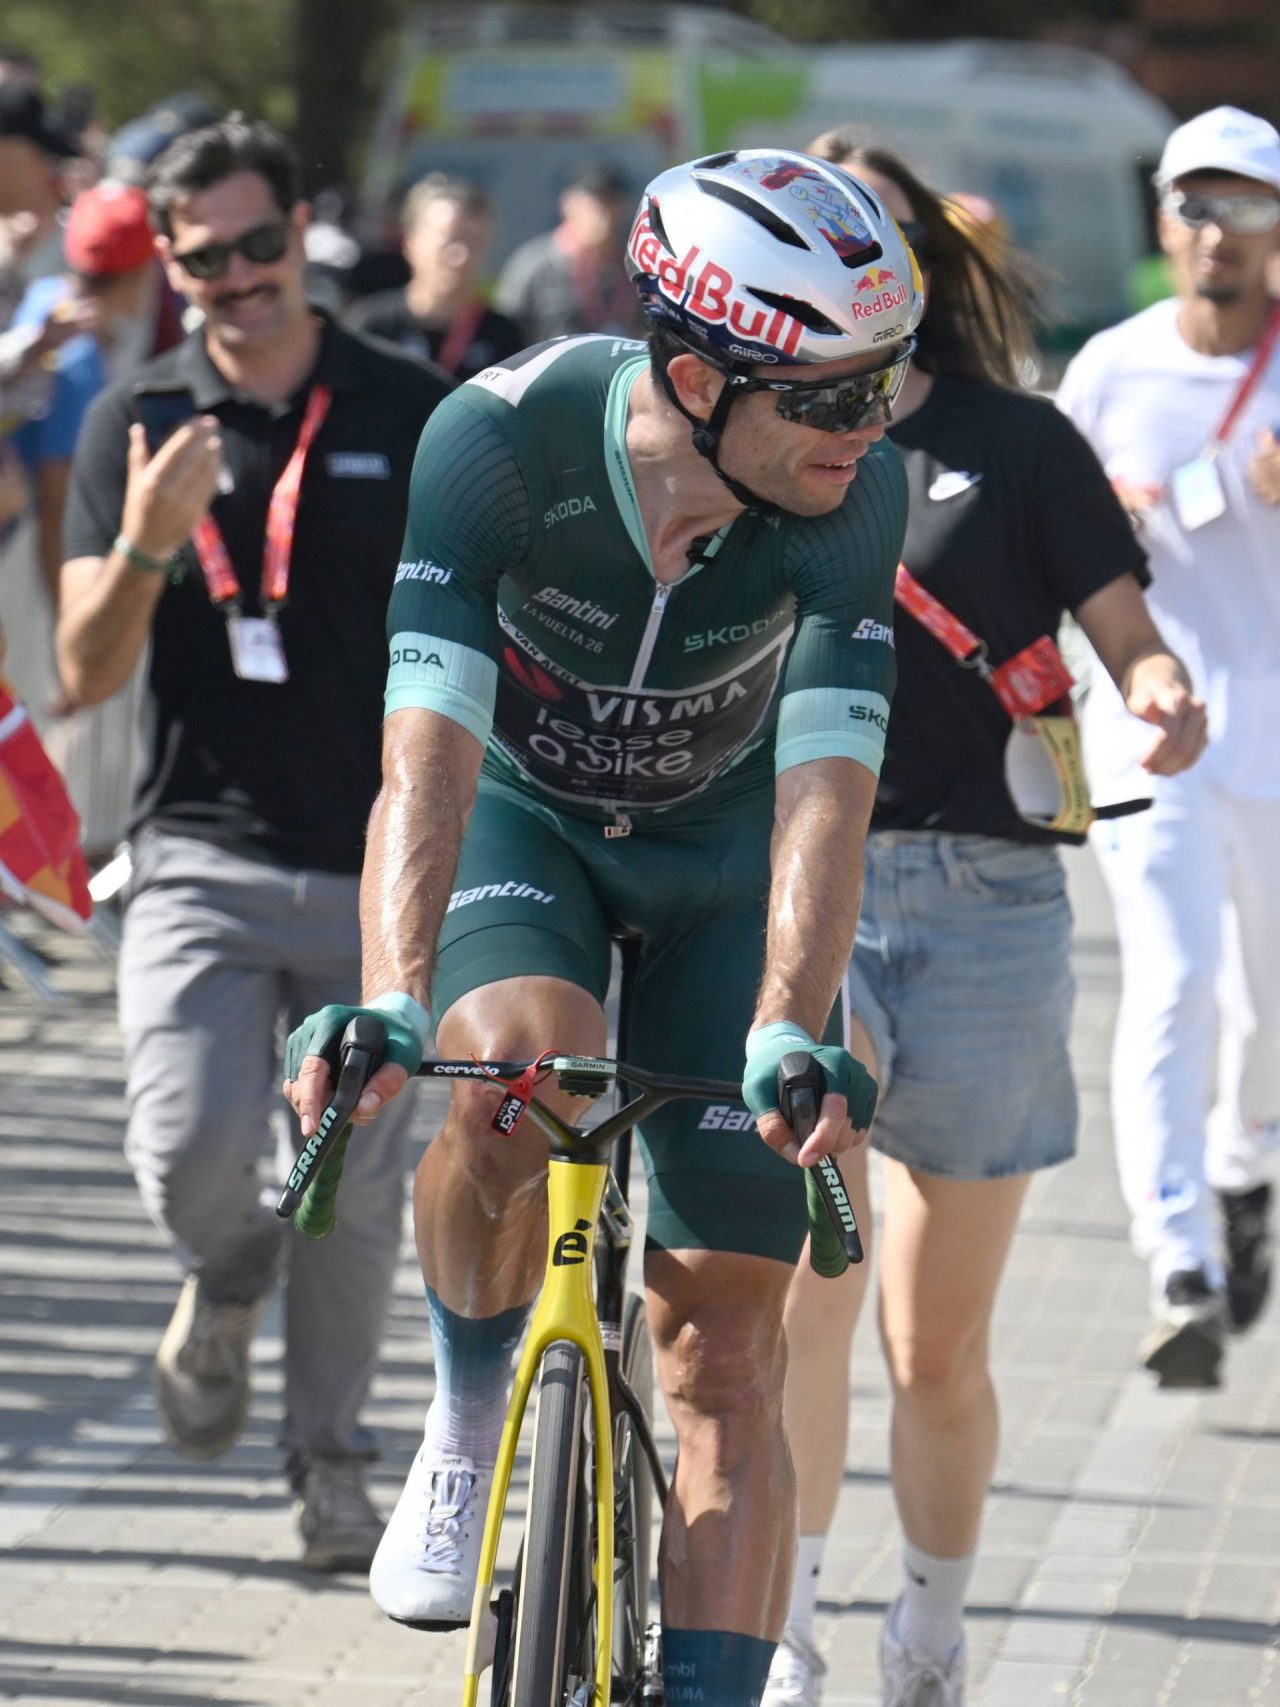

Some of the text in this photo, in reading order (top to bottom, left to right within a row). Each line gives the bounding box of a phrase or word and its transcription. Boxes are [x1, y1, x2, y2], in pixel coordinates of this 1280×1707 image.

[687, 261, 812, 357] Bull
[851, 285, 907, 320] Red Bull
[873, 324, 904, 343] GIRO
[728, 343, 778, 364] GIRO
[394, 560, 454, 585] antini
[531, 586, 620, 630] Santini
[514, 630, 539, 656] VAN
[538, 612, 584, 645] VUELTA
[584, 639, 605, 654] 26
[392, 648, 445, 669] ODA
[586, 681, 748, 726] VISMA
[849, 705, 888, 733] SKO
[536, 707, 694, 751] lease
[528, 734, 567, 767] a
[570, 1061, 606, 1070] GARMIN
[288, 1105, 338, 1192] SRAM
